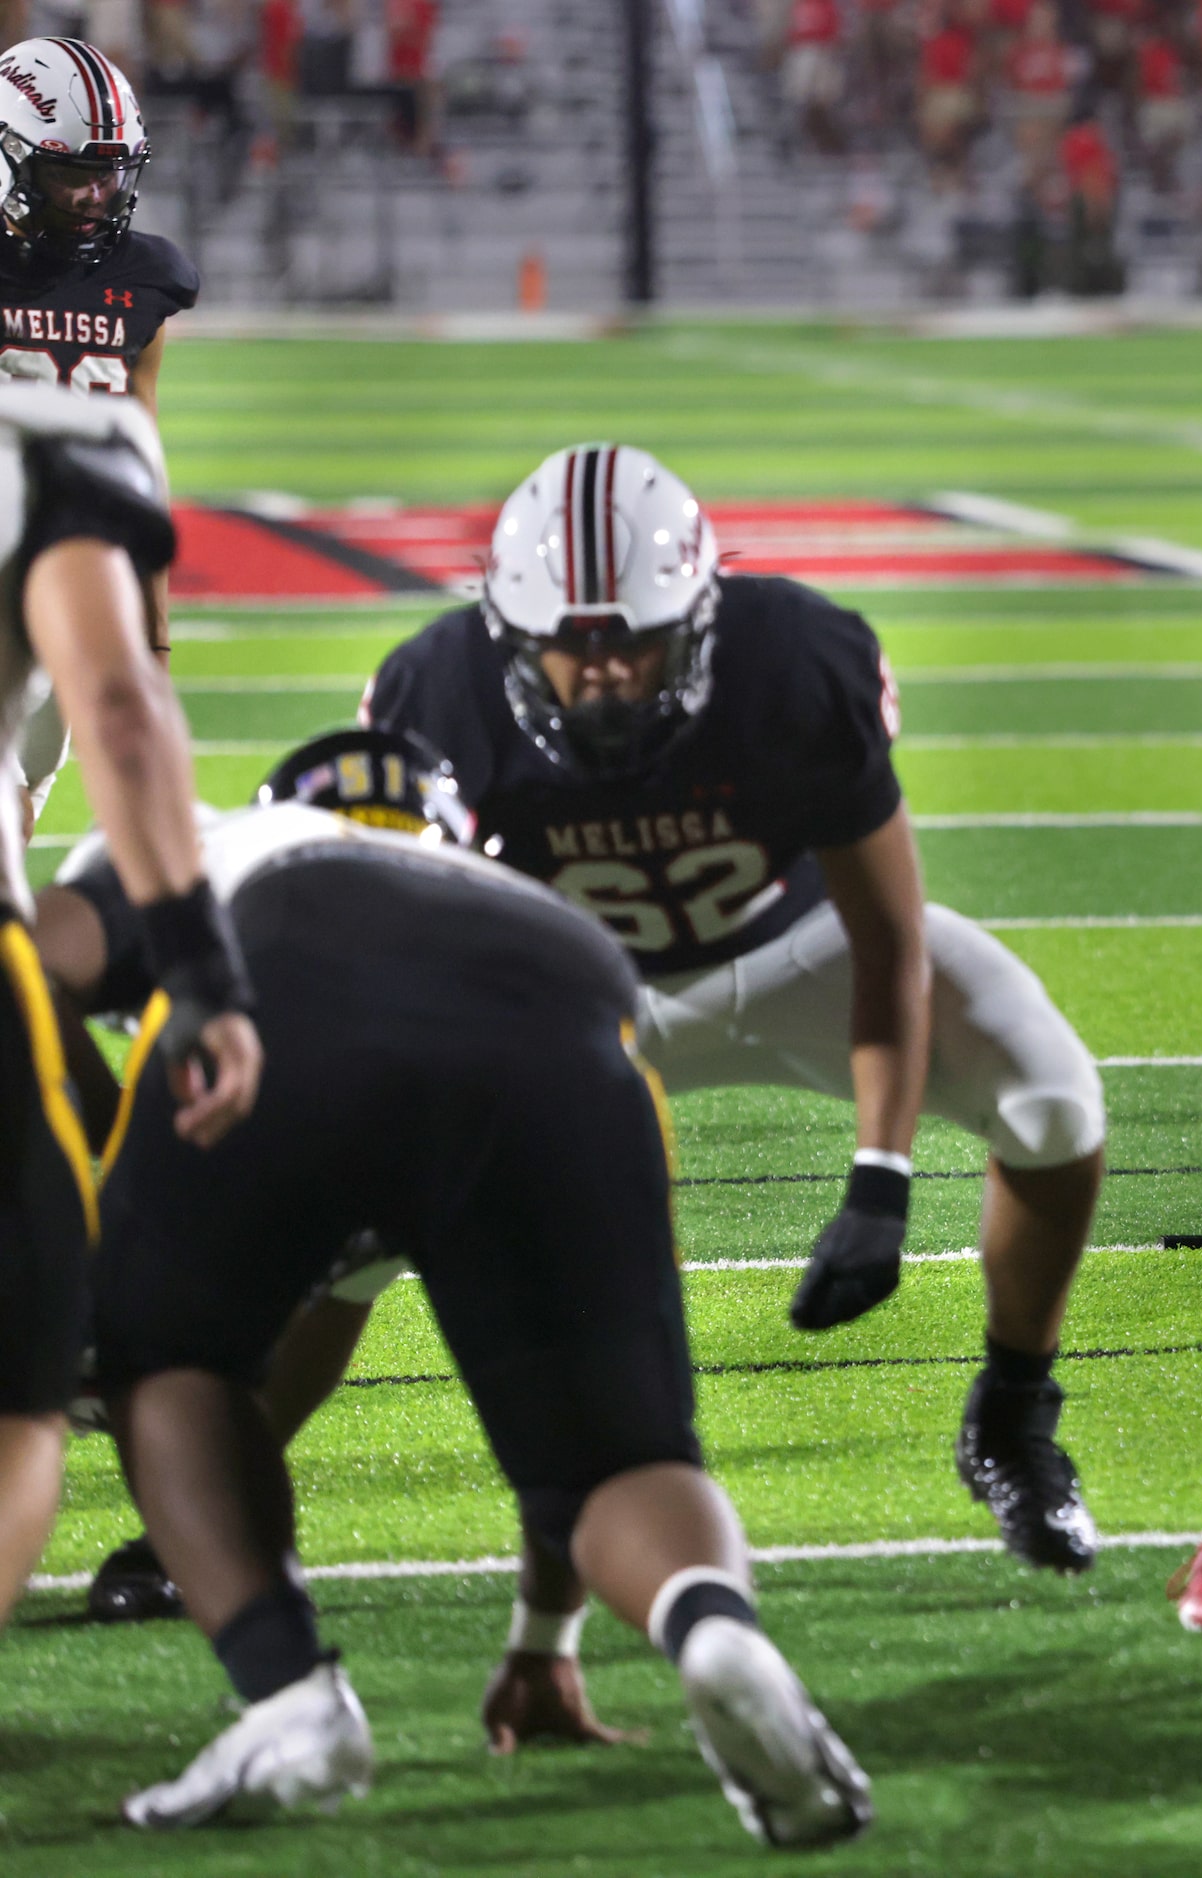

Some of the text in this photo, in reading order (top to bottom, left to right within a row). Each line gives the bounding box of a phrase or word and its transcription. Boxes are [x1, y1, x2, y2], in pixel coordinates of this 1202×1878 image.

[2, 308, 126, 347] MELISSA
[334, 751, 405, 800] 51
[546, 808, 733, 857] MELISSA
[551, 839, 768, 953] 62
